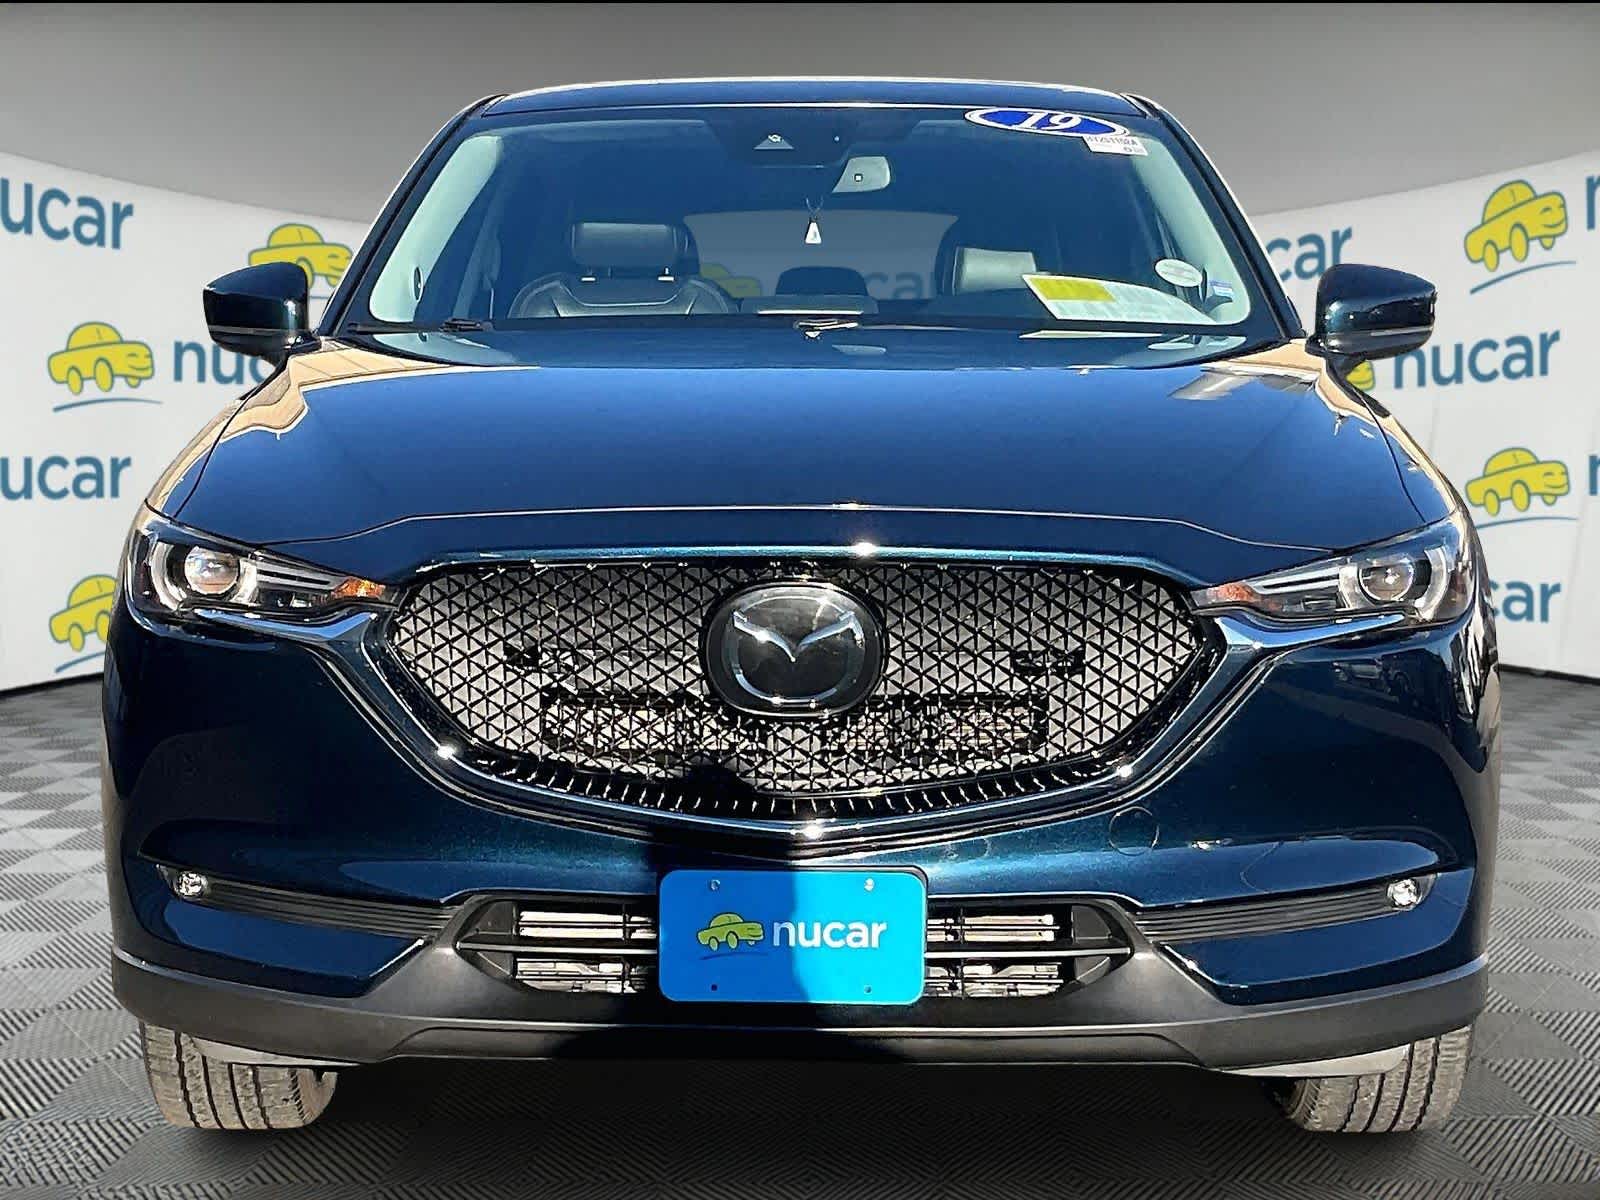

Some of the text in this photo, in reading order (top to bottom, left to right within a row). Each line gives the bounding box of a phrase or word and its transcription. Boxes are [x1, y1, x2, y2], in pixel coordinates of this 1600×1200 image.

[1013, 111, 1082, 131] 19
[0, 177, 134, 250] ucar
[1394, 330, 1560, 389] nucar
[0, 455, 132, 501] ucar
[1489, 581, 1562, 623] ar
[773, 920, 888, 949] nucar
